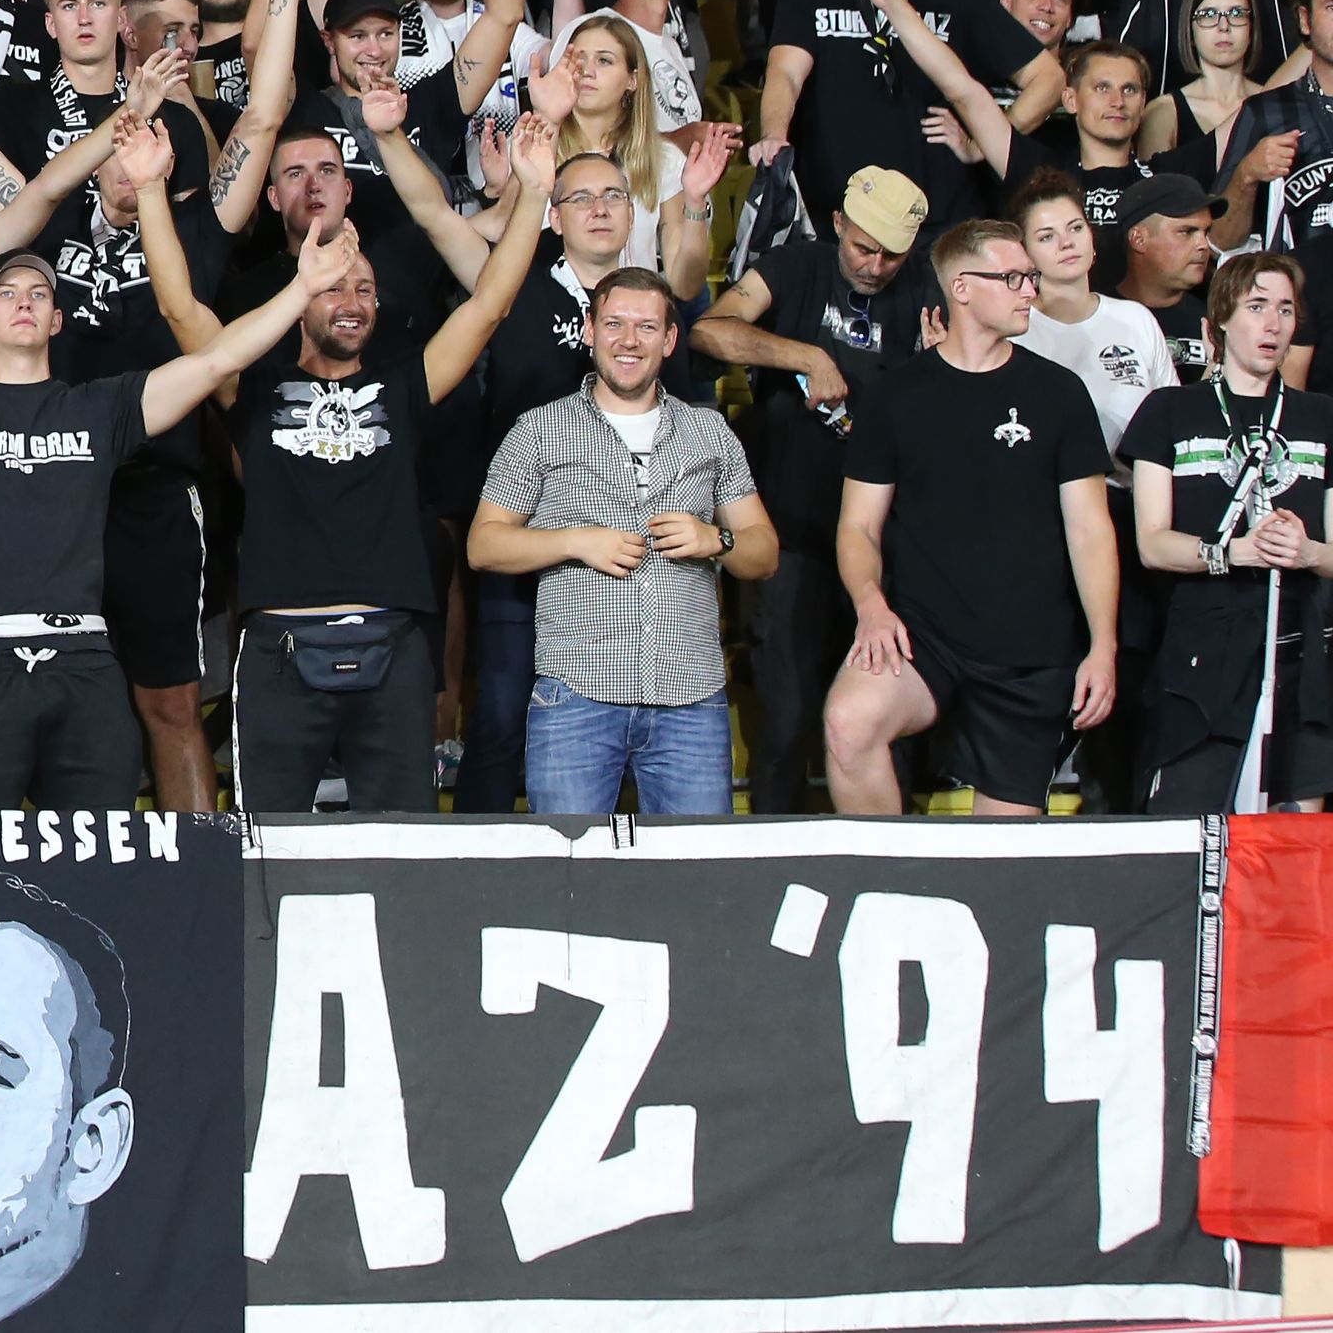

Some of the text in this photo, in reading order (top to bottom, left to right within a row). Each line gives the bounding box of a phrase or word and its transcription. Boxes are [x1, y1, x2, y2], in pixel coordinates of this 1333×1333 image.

[56, 246, 92, 277] BG
[29, 431, 93, 457] GRAZ
[770, 882, 1165, 1253] '94
